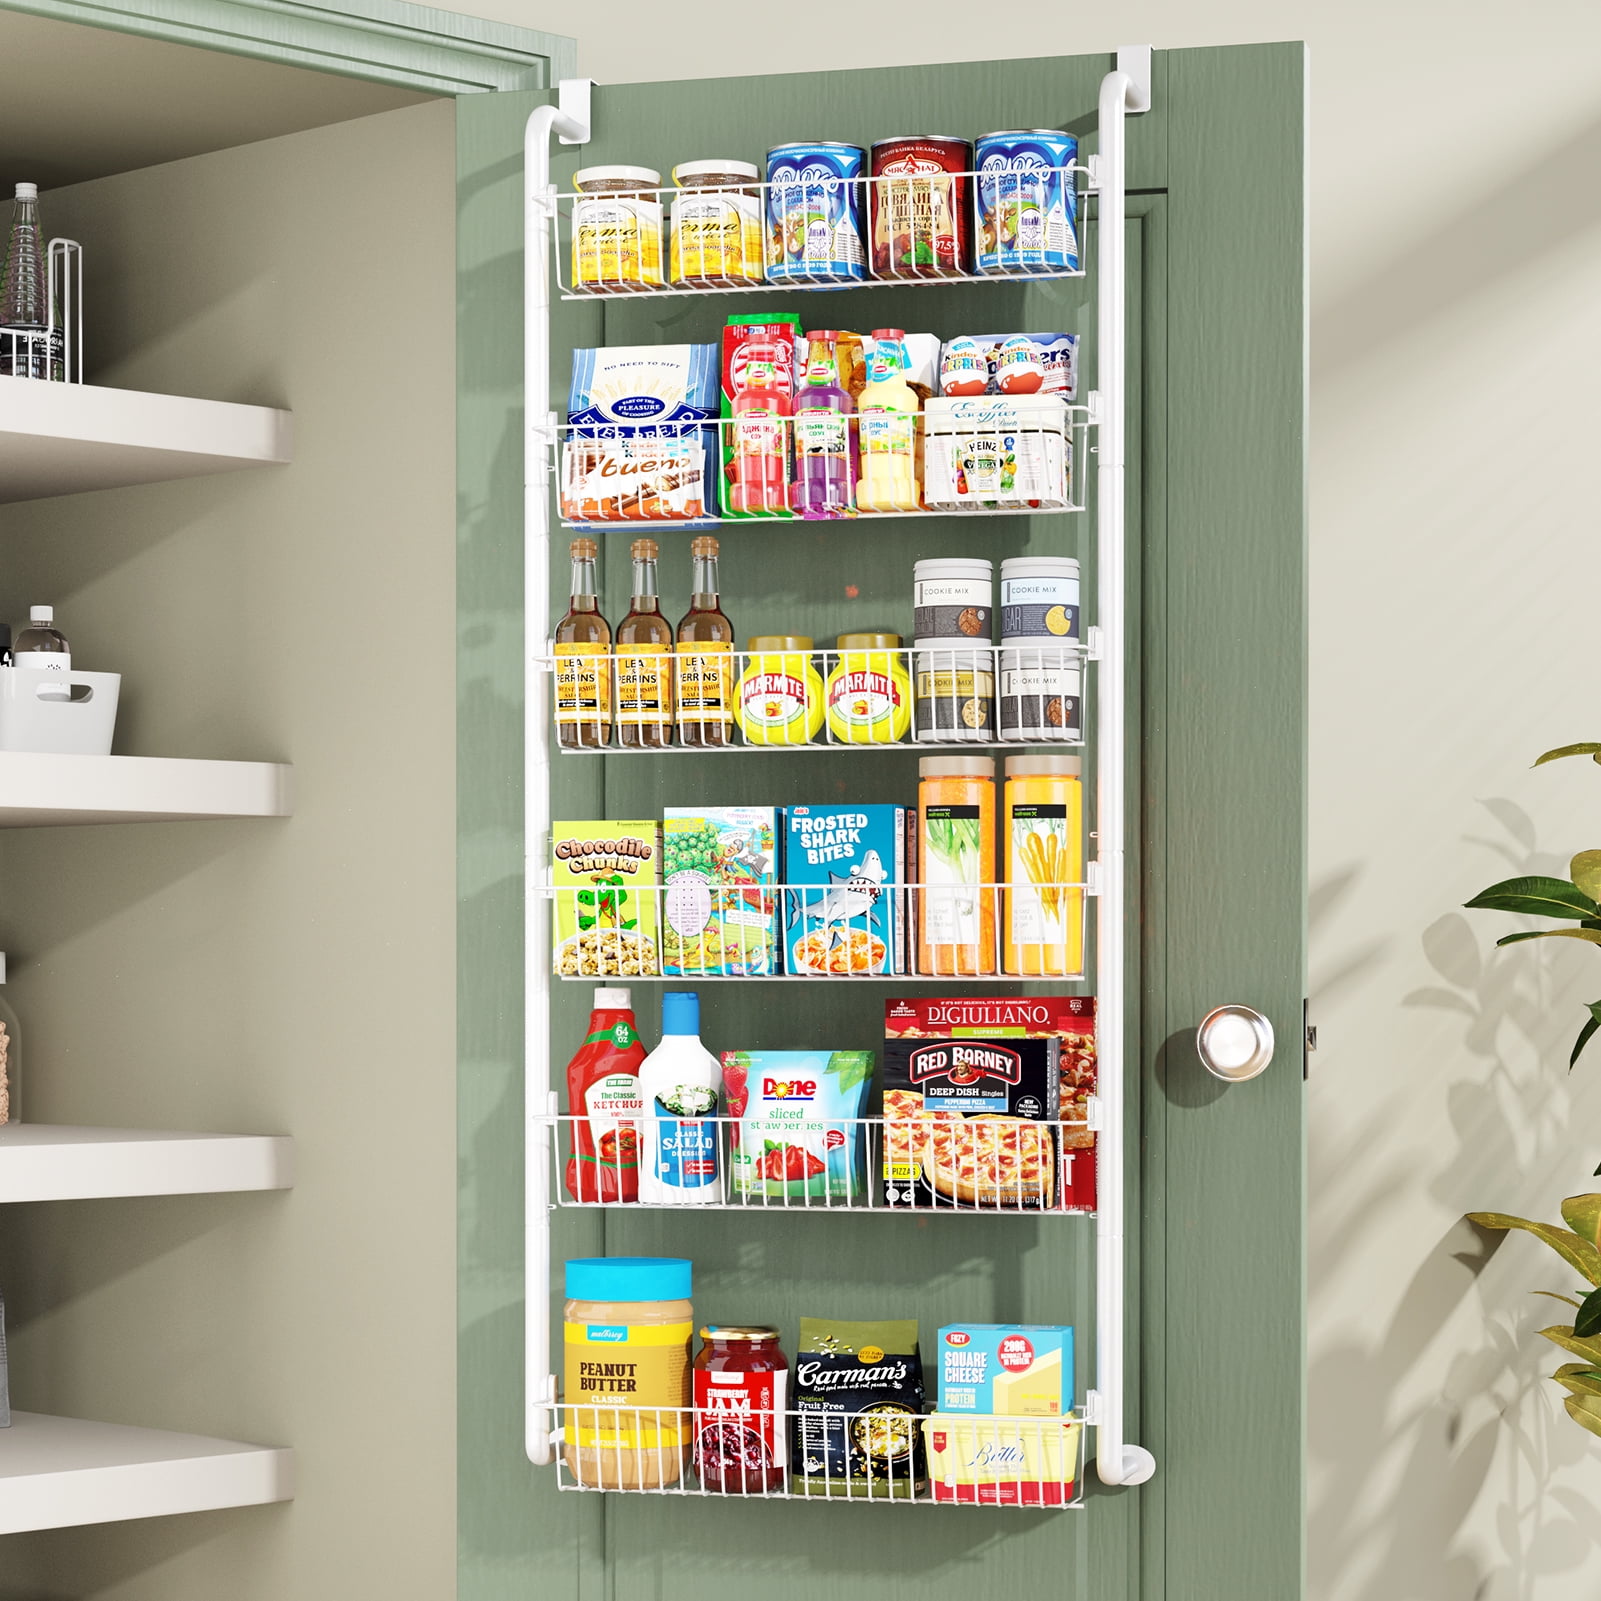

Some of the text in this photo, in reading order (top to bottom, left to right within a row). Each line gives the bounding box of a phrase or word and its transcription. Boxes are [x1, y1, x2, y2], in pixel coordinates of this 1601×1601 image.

[601, 456, 691, 477] bueno
[924, 587, 953, 595] COOKIE
[563, 658, 583, 667] LEA
[625, 659, 645, 668] LEA
[686, 657, 706, 667] LEA
[791, 813, 869, 833] FROSTED
[800, 828, 861, 849] SHARK
[555, 837, 653, 860] Chocodile
[807, 843, 855, 864] BITES
[568, 855, 639, 874] Chunks
[615, 1025, 629, 1037] 64
[917, 1046, 1015, 1076] RED BARNEY
[601, 1091, 637, 1100] The Classic
[929, 1088, 1004, 1098] DEEP DISH Singles
[769, 1108, 804, 1119] sliced
[662, 1137, 713, 1150] SALAD
[945, 1351, 988, 1368] SQUARE
[580, 1362, 637, 1377] PEANUT
[797, 1361, 907, 1387] Carman's
[945, 1367, 986, 1383] CHEESE
[580, 1377, 637, 1392] BUTTER
[591, 1395, 628, 1404] CLASSIC
[798, 1401, 845, 1410] Fruit Free
